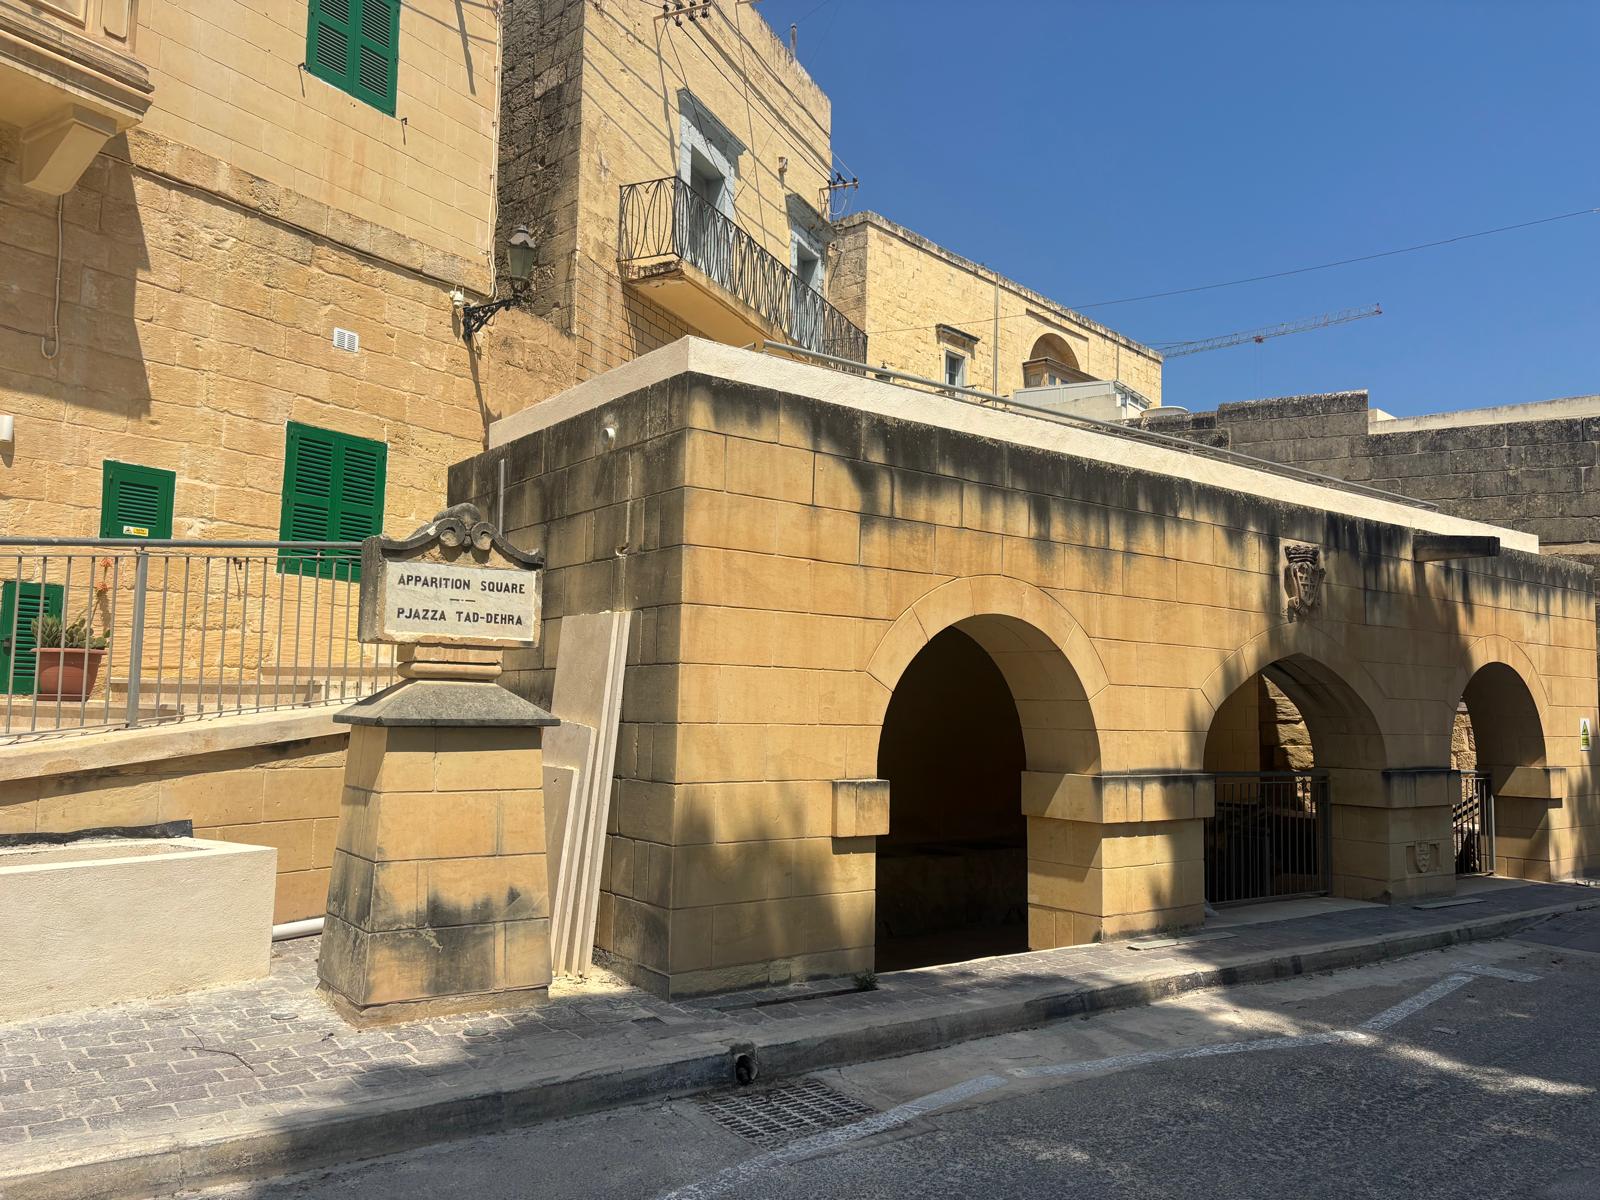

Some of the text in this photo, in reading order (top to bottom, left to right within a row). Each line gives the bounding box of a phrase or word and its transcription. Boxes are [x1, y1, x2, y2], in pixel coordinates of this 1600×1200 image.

[398, 573, 526, 594] APPARITION SQUARE
[396, 607, 523, 625] PJAZZA TAD-DEHRA
